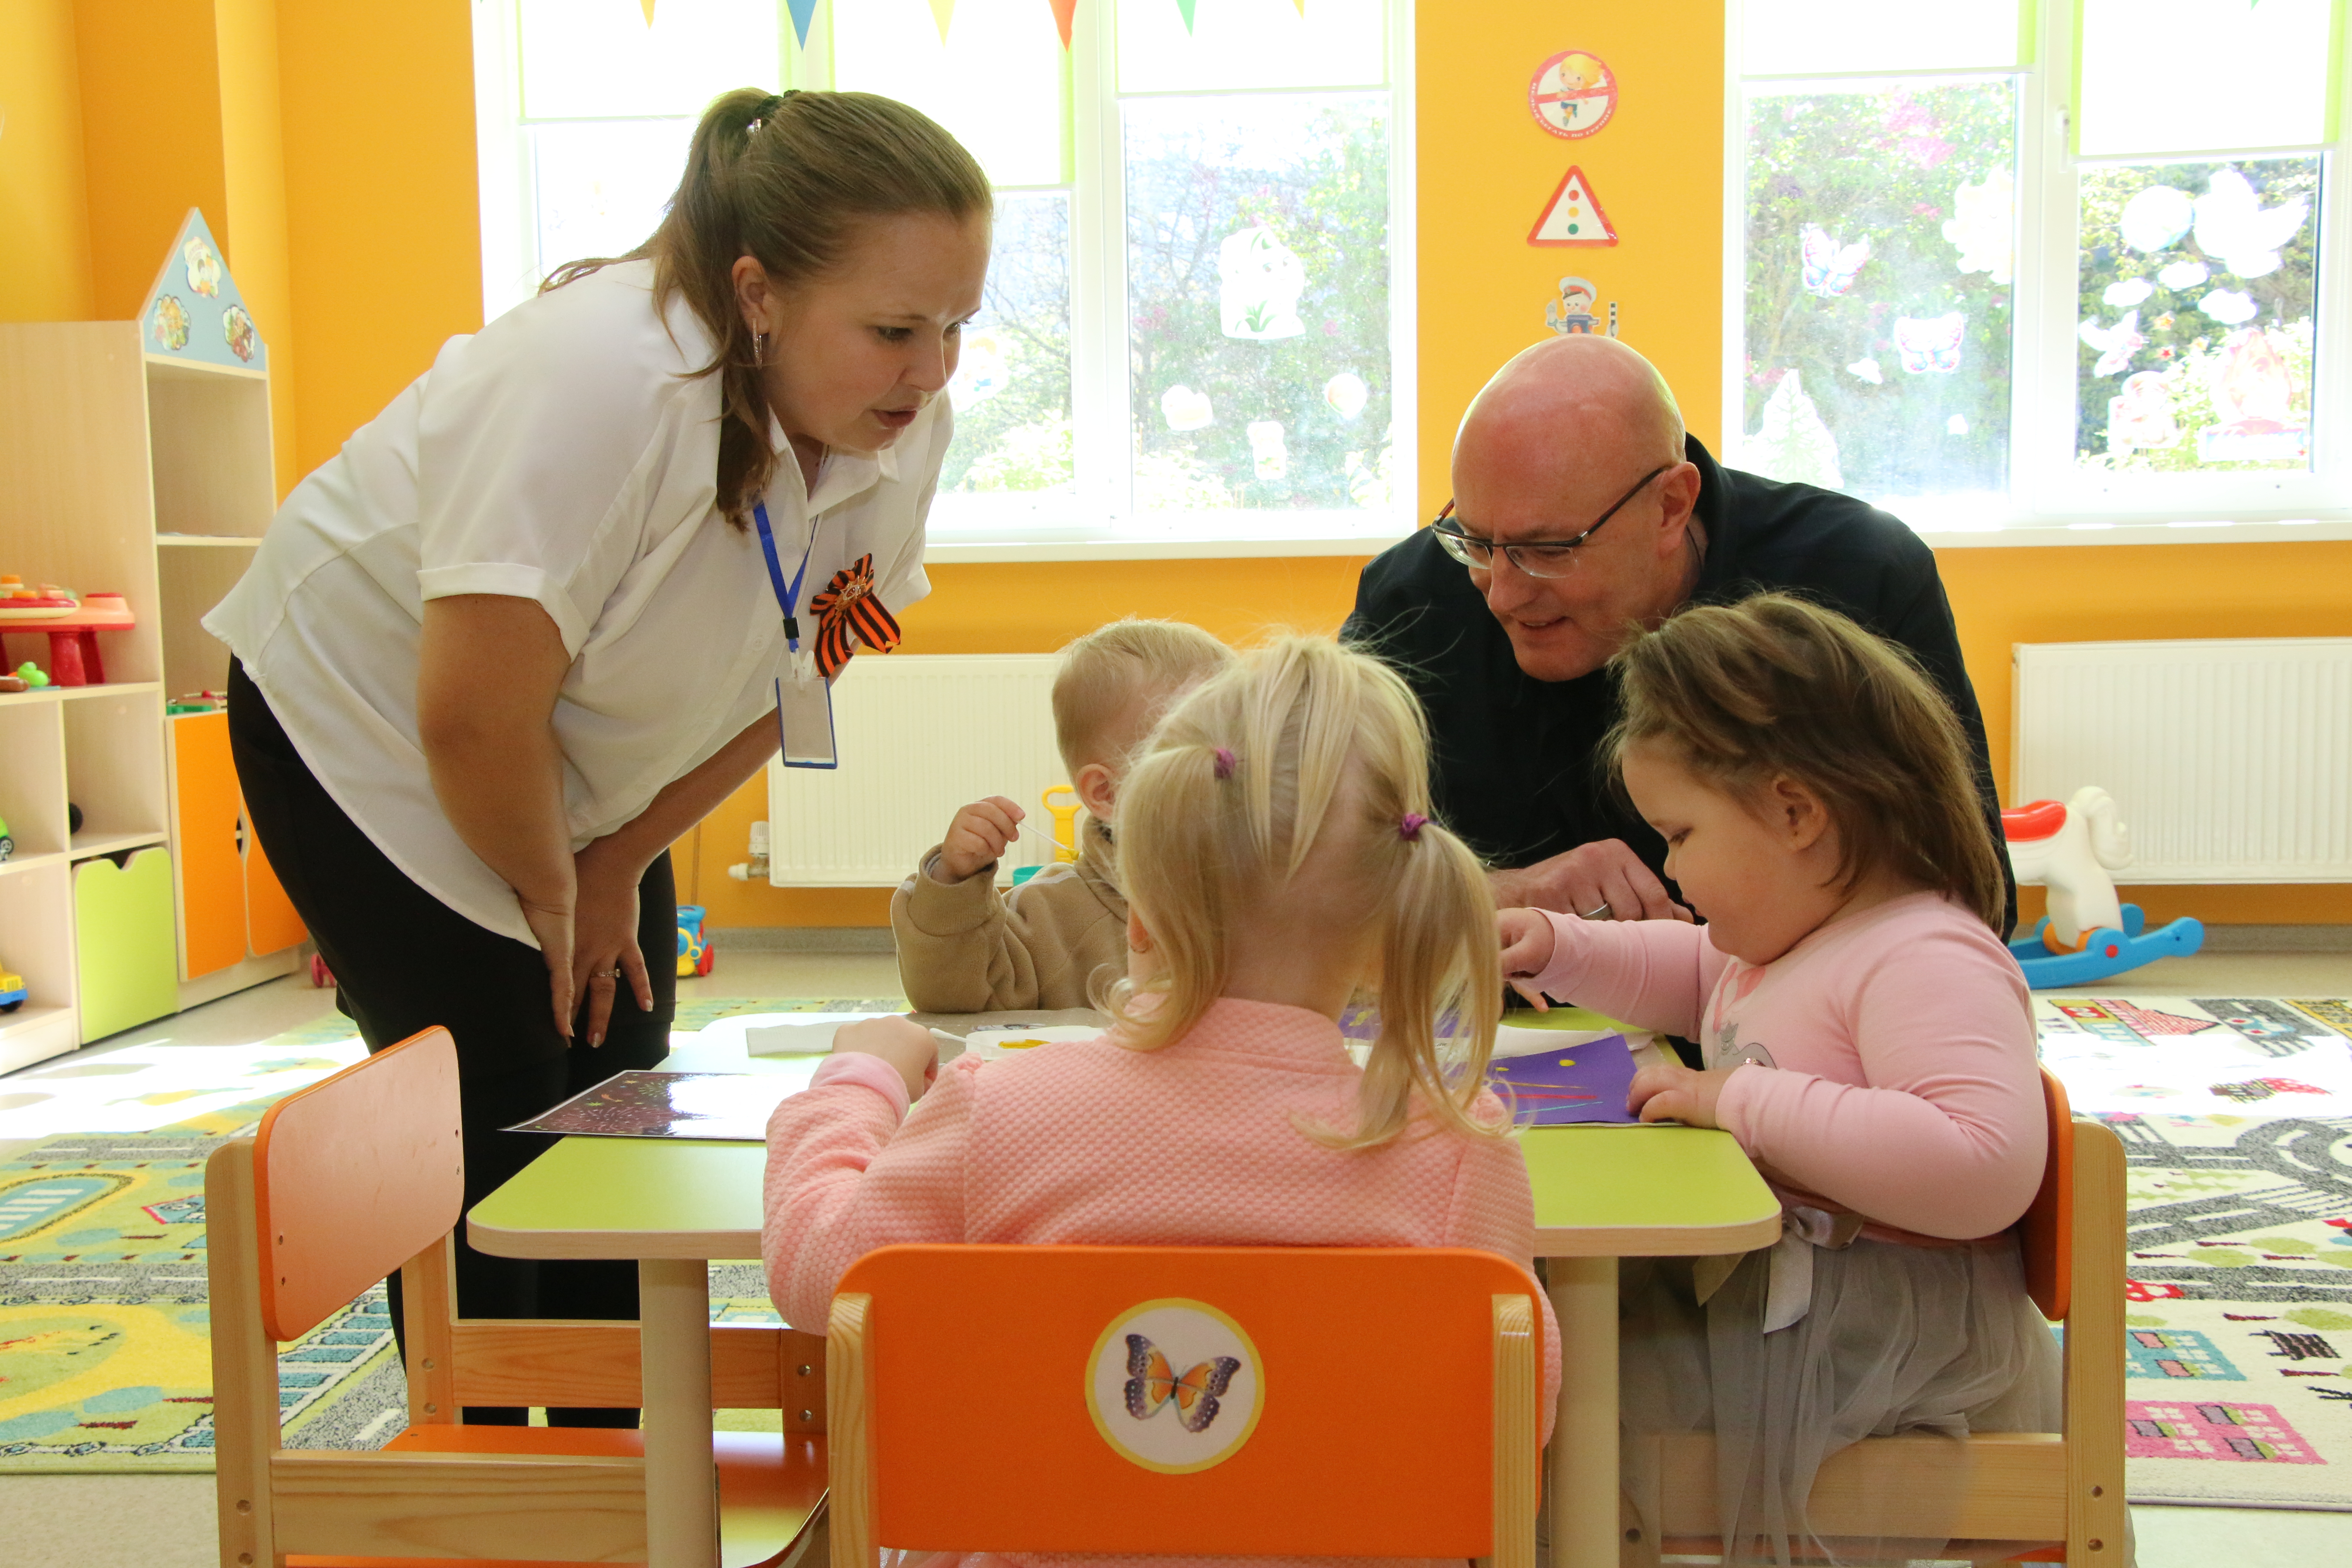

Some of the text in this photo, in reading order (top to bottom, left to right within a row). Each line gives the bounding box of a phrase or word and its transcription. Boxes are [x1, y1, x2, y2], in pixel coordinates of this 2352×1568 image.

[1531, 83, 1540, 118] НЕЛЬЗЯ
[1540, 120, 1568, 137] БЕГАТЬ
[1586, 110, 1612, 135] ГРУППЕ
